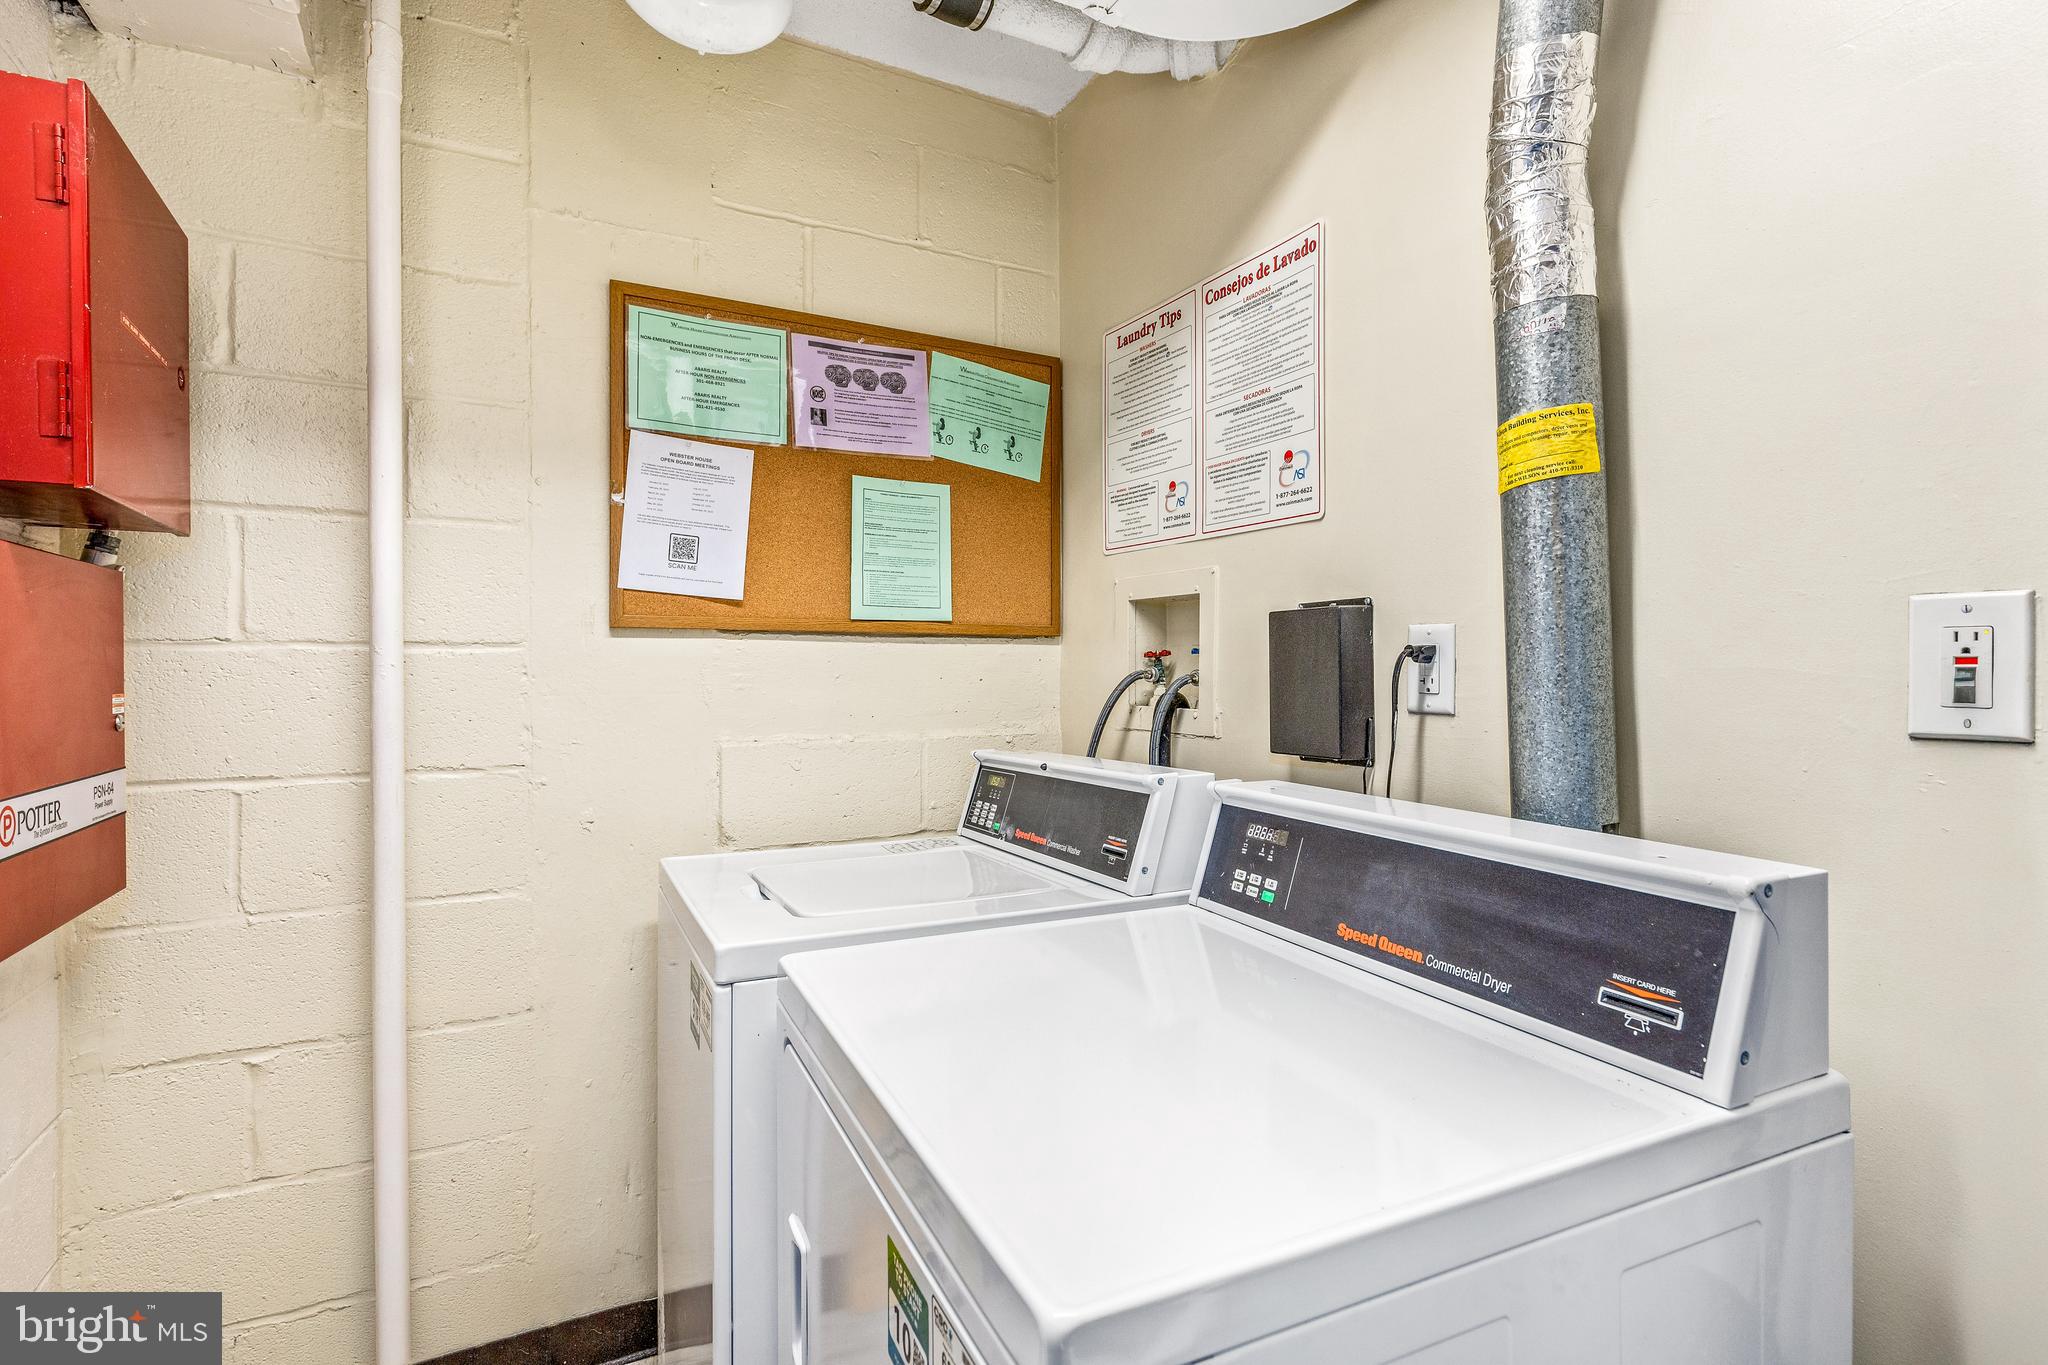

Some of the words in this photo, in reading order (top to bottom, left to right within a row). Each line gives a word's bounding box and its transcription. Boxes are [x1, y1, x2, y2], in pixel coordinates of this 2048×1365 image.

[1205, 272, 1253, 305] Consejos
[1256, 262, 1270, 280] de
[1273, 238, 1316, 272] Lavado
[1243, 285, 1271, 303] LAVADORAS
[1117, 322, 1157, 349] Laundry
[1159, 309, 1181, 328] Tips
[640, 334, 683, 346] NON-EMERGENCIES
[693, 343, 723, 353] EMERGENCIES
[670, 346, 690, 354] BUSINESS
[1243, 387, 1271, 401] SECADORAS
[1508, 416, 1537, 430] Building
[1539, 409, 1575, 421] Services,
[1551, 426, 1565, 434] dryer
[669, 452, 694, 460] WEBSTER
[695, 462, 720, 470] MEETINGS
[1525, 463, 1544, 474] cleaning
[1546, 461, 1564, 470] service
[94, 782, 114, 800] PSN-64
[17, 800, 61, 835] POTTER
[1015, 828, 1030, 841] Speed
[1337, 922, 1377, 947] Speed
[1426, 955, 1481, 983] Commercial
[1483, 973, 1512, 994] Dryer
[1613, 973, 1636, 985] INSERT
[1637, 978, 1656, 991] CARD
[1657, 984, 1676, 997] HERE
